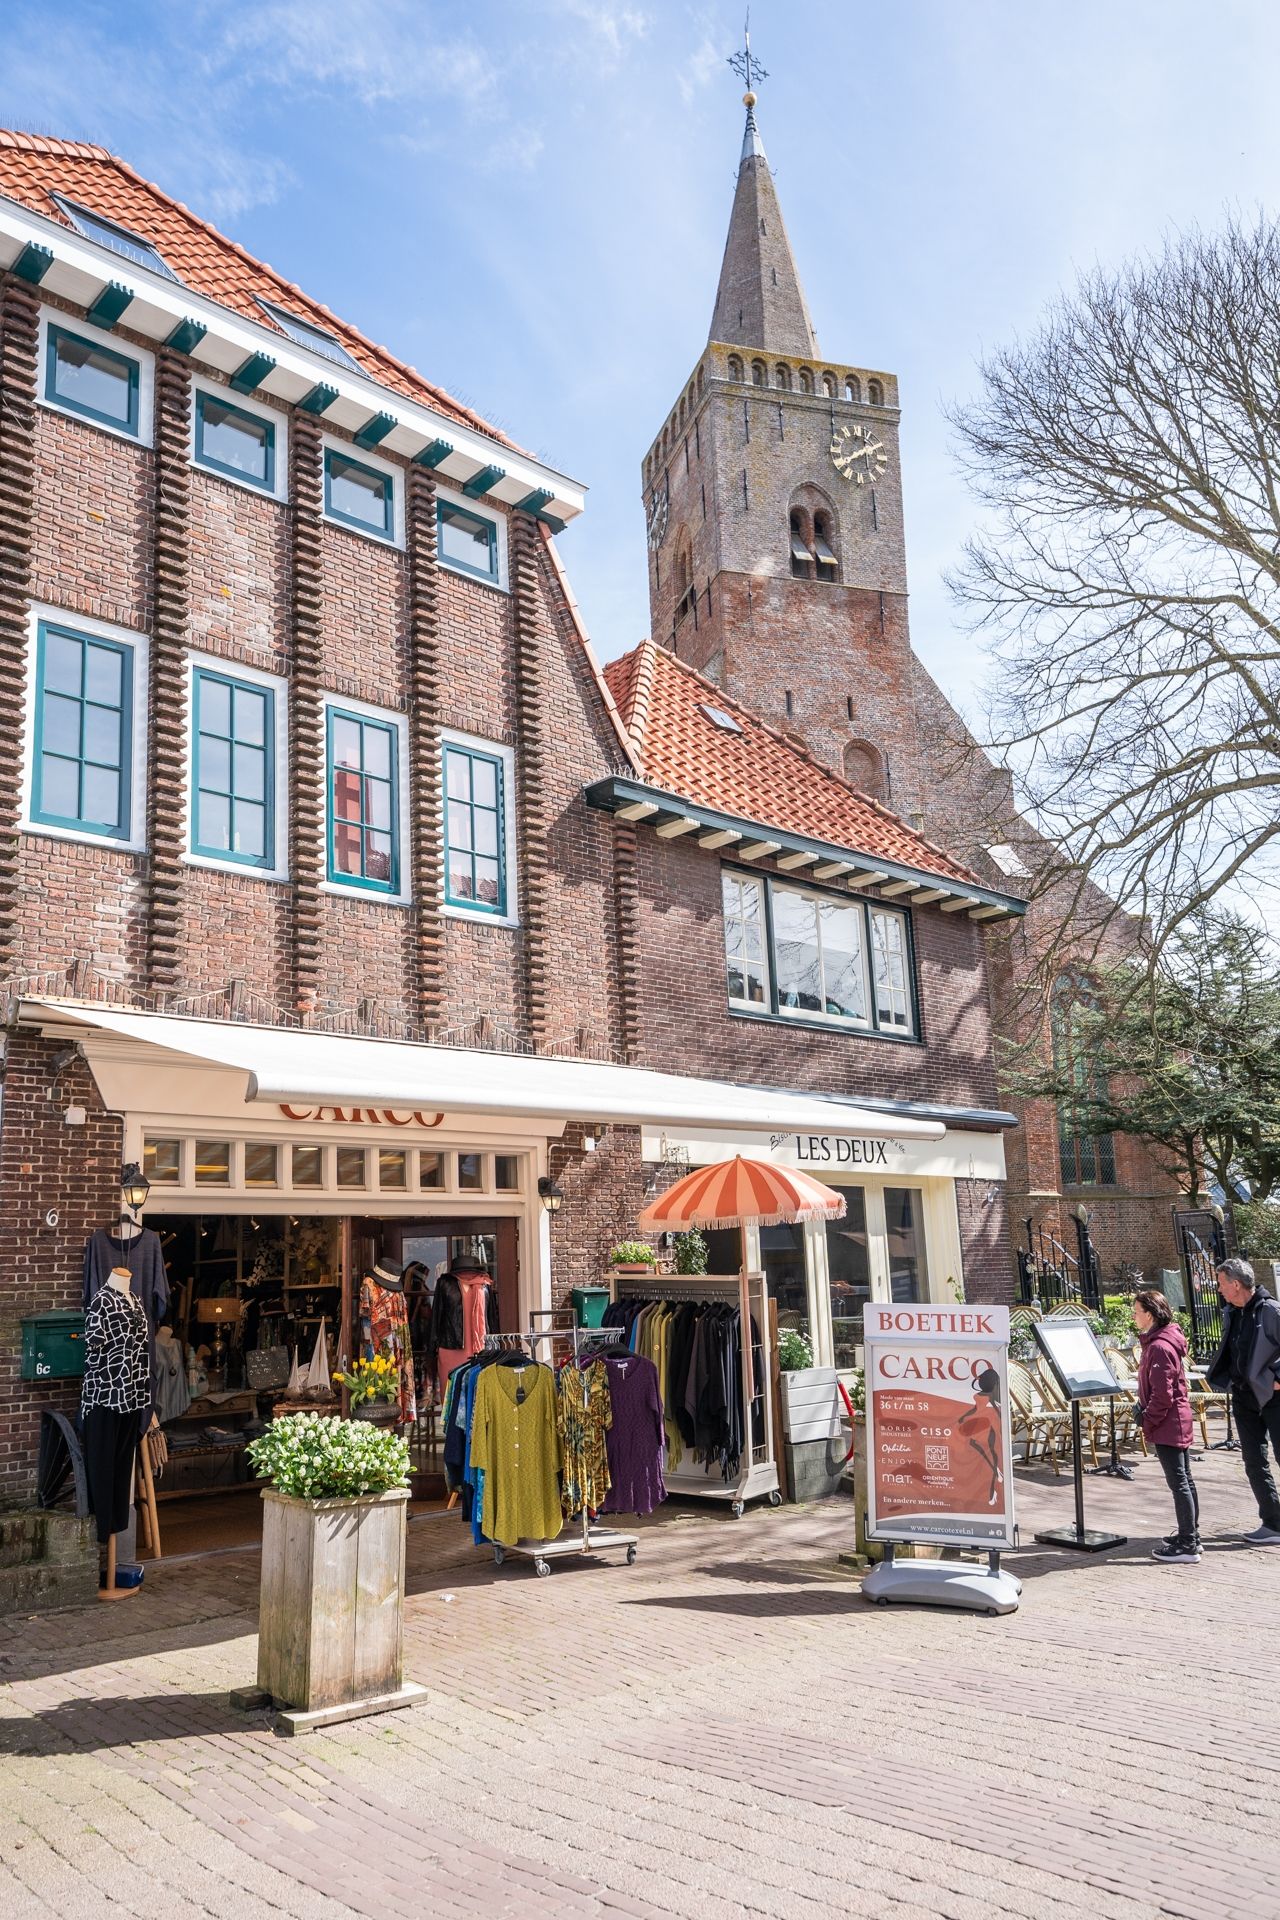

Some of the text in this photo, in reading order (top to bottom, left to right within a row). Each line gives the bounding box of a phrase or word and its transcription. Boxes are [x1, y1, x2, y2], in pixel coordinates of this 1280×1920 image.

[796, 1135, 831, 1161] LES
[835, 1138, 888, 1164] DEUX
[45, 1207, 59, 1227] 6
[878, 1312, 994, 1333] BOETIEK
[878, 1354, 993, 1381] CARCO
[879, 1400, 929, 1411] 36 t/m 58
[920, 1427, 952, 1436] CISO
[881, 1444, 912, 1453] Ophilia
[893, 1497, 917, 1505] andere
[910, 1525, 974, 1536] www.carcotexel.nl
